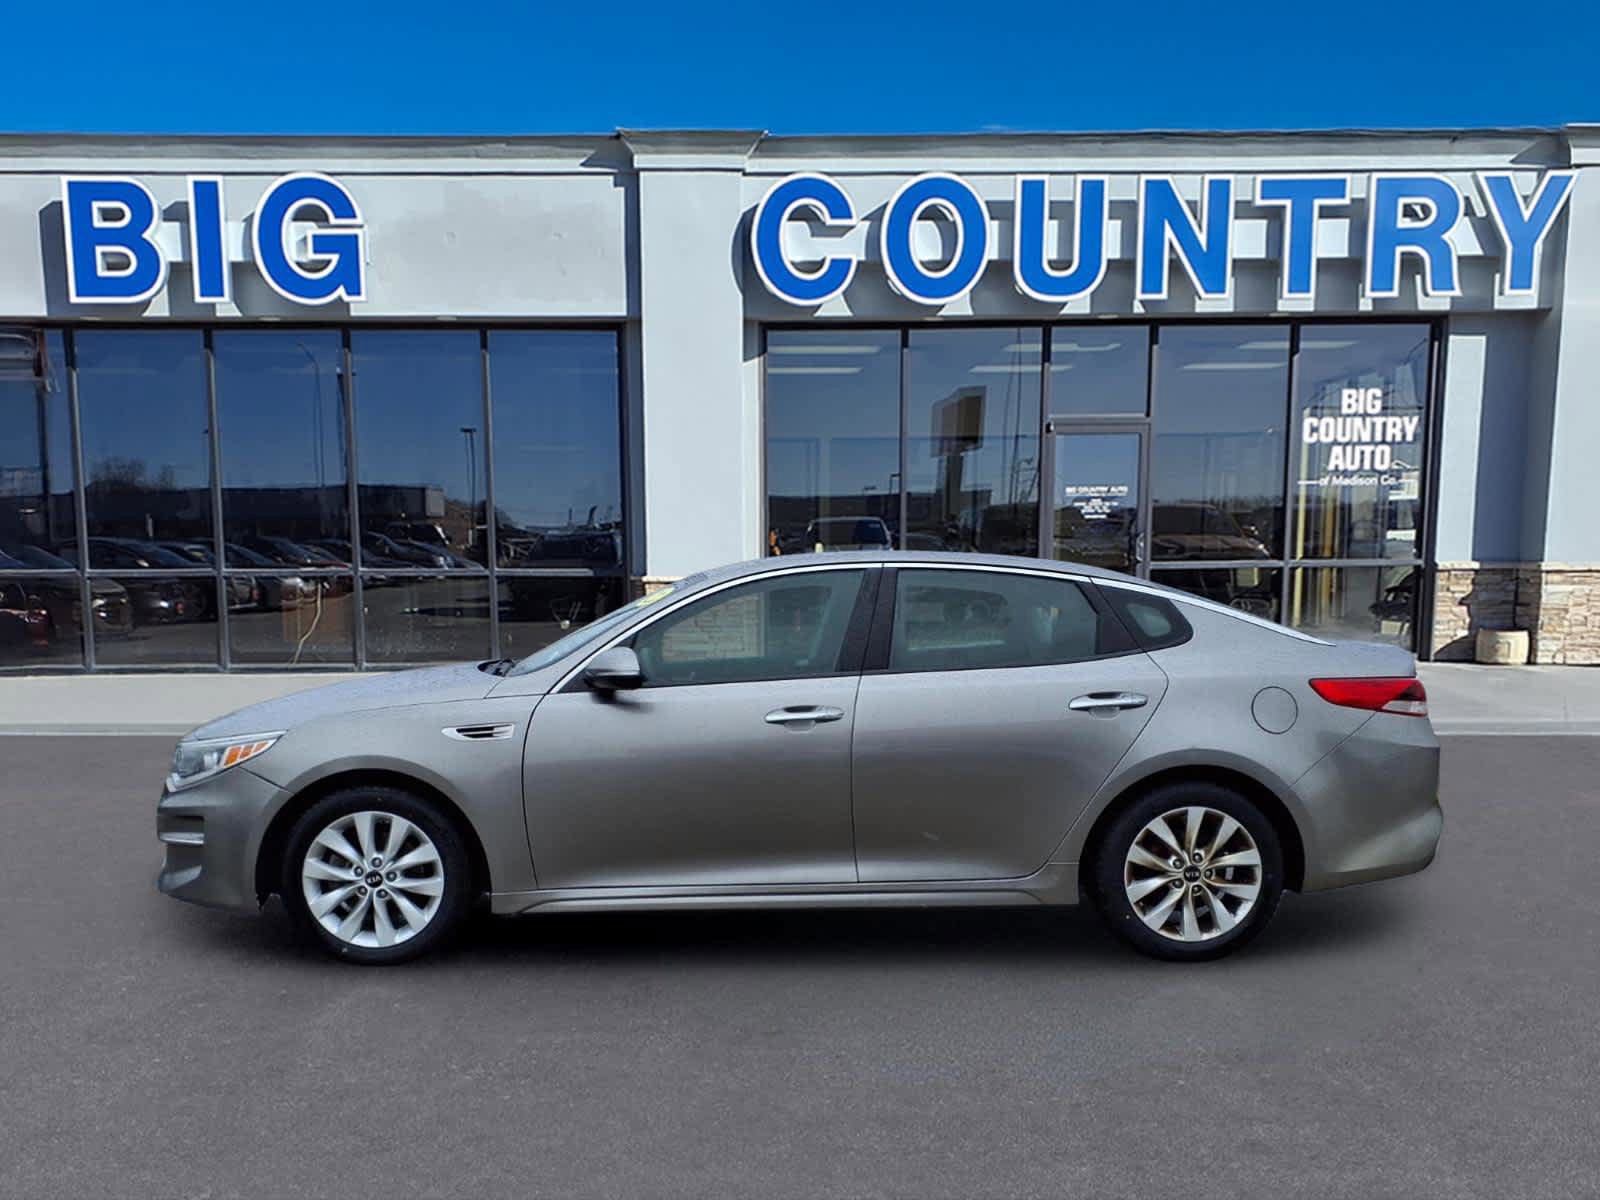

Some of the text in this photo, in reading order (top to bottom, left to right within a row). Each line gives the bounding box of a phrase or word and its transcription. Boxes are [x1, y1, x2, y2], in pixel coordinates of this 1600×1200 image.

[60, 171, 1575, 306] BIG COUNTRY
[1342, 388, 1382, 414] BIG
[1303, 416, 1419, 442] COUNTRY
[1328, 444, 1391, 471] AUTO
